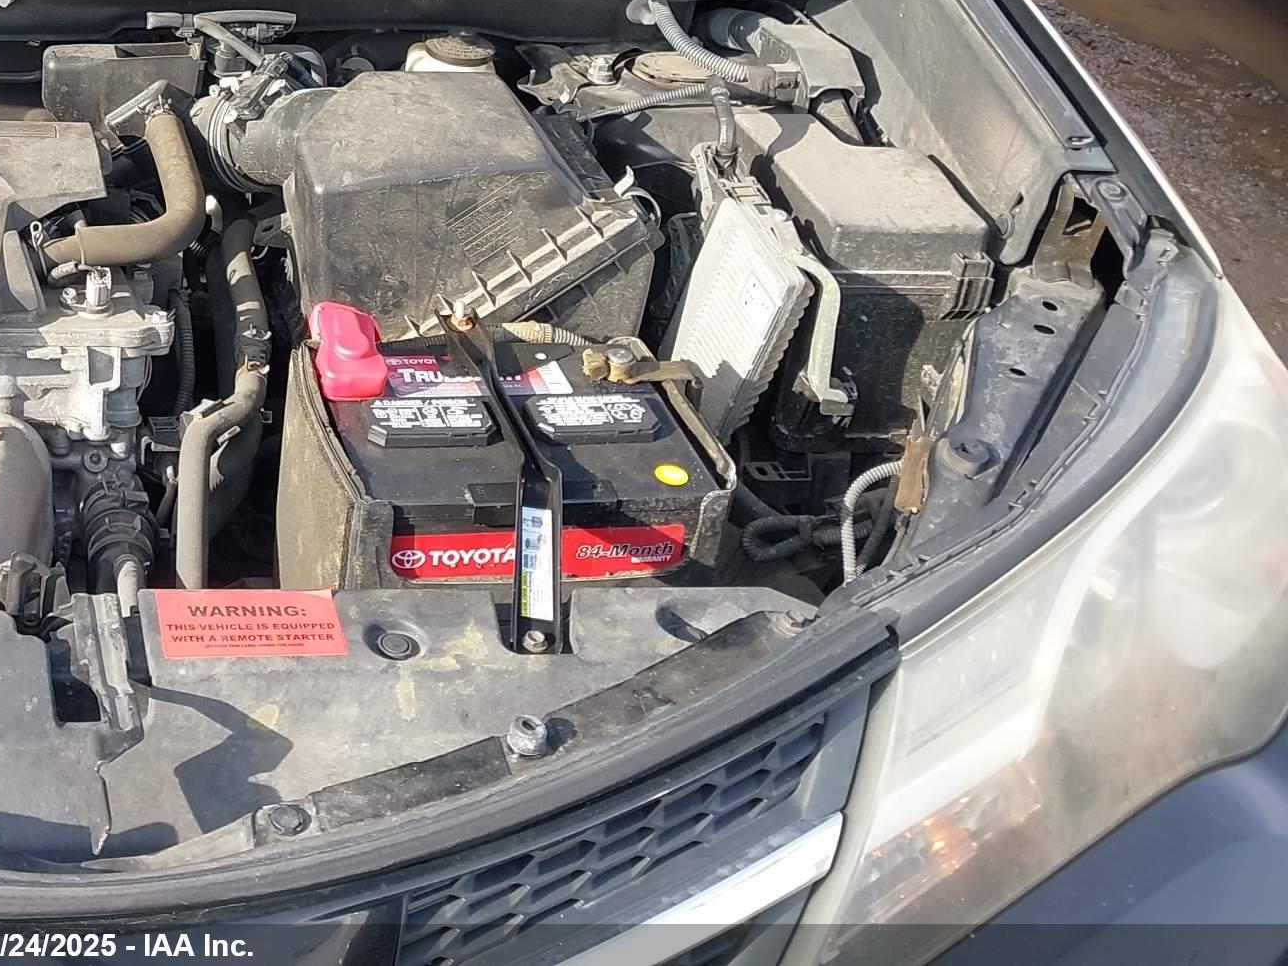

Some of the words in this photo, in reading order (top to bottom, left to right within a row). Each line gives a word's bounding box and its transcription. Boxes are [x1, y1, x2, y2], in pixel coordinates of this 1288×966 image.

[429, 548, 515, 566] TOYOTA
[576, 542, 674, 559] 84-Month
[187, 606, 306, 617] WARNING:
